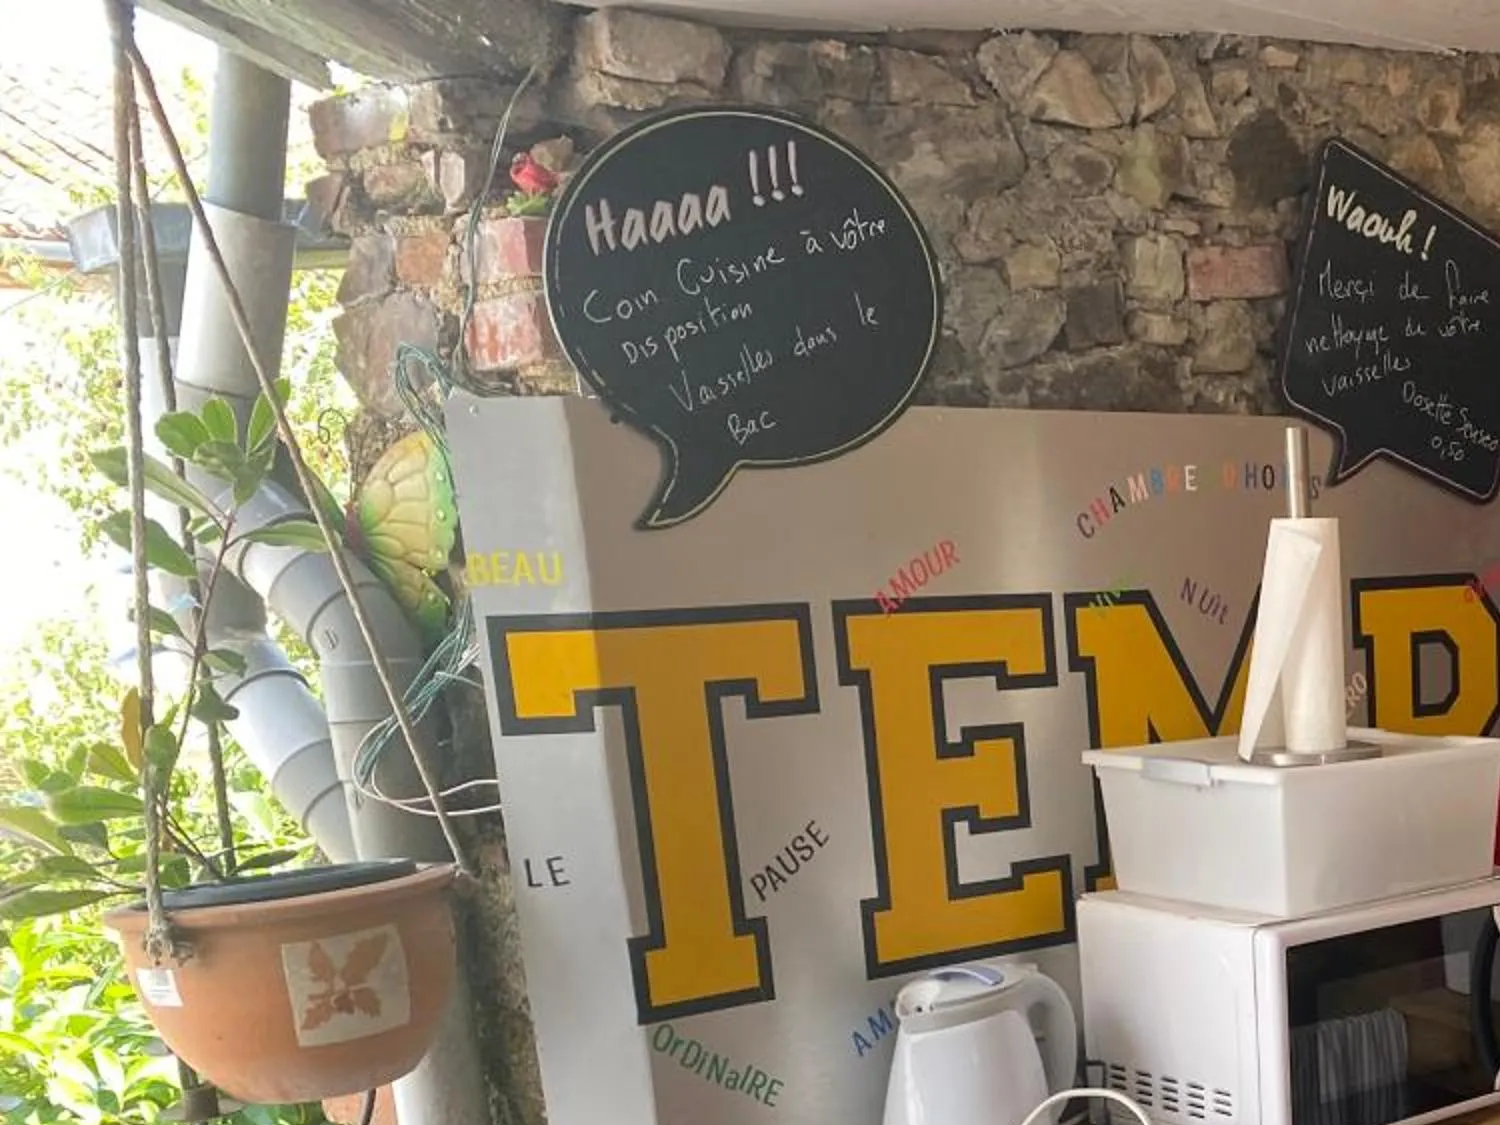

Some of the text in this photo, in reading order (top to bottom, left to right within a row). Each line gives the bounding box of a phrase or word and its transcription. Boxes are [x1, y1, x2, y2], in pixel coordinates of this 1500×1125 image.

[583, 288, 657, 323] Coin
[676, 246, 784, 295] Cuisine
[1399, 270, 1431, 301] de
[853, 290, 880, 326] le
[621, 296, 753, 364] Disposition
[727, 410, 777, 446] Bac
[466, 549, 565, 587] BEAU
[872, 541, 960, 617] AMOUR
[523, 855, 571, 888] LE
[748, 820, 831, 902] PAUSE
